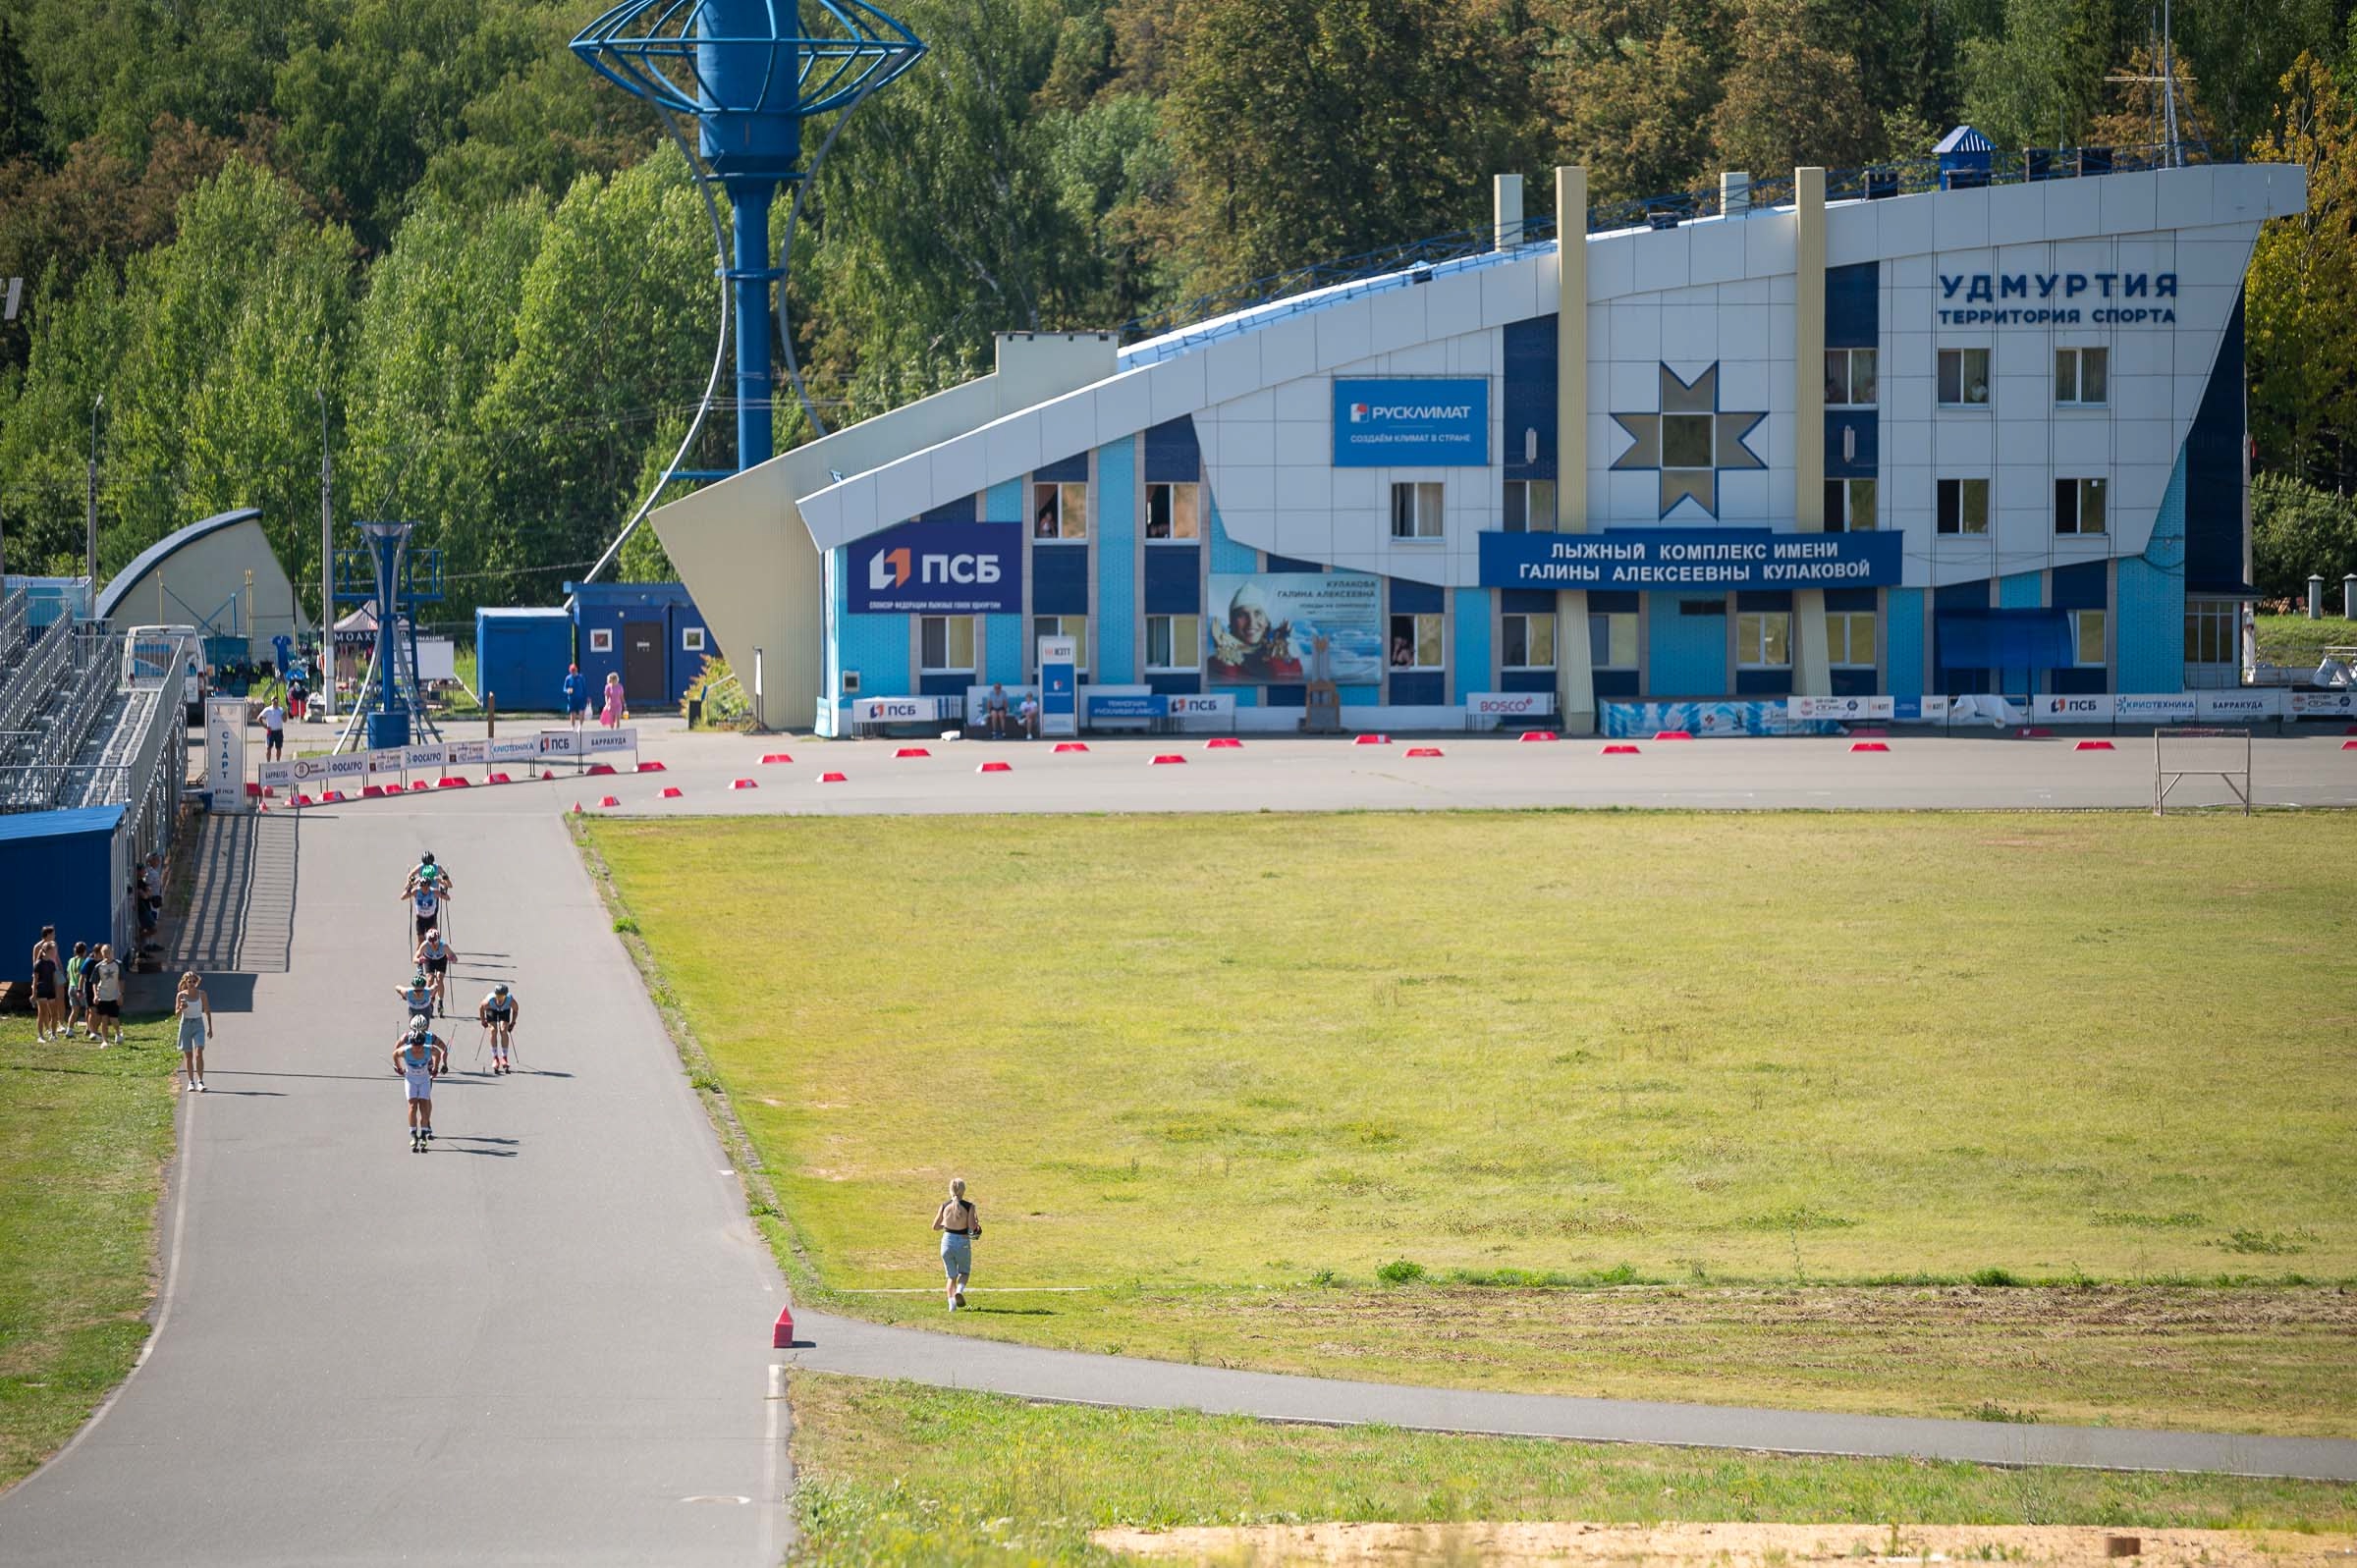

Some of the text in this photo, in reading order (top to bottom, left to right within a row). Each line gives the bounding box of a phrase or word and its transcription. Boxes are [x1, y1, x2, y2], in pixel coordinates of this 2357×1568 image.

[1939, 273, 2178, 303] УДМУРТИЯ
[1938, 308, 2176, 325] ТЕРРИТОРИЯ СПОРТА
[1372, 406, 1471, 419] РУСКЛИМАТ
[1551, 542, 1838, 561] ЛЫЖНЫЙ КОМПЛЕКС ИМЕНИ
[921, 554, 1001, 583] ПСБ
[1519, 559, 1870, 581] ГАЛИНЫ АЛЕКСЕЕВНЫ КУЛАКОВОЙ
[1188, 699, 1217, 711] ПСБ
[1480, 700, 1526, 713] BOSCO
[2069, 699, 2097, 711] ПСБ
[2127, 699, 2194, 709] КРИОТЕХНИКА
[2213, 701, 2263, 710] БАРРАКУДА
[888, 705, 916, 717] ПСБ
[551, 737, 570, 750] ПСБ
[590, 737, 626, 746] БАРРАКУДА
[412, 752, 441, 763] ФОСАГРО
[332, 761, 362, 773] ФОСАГРО
